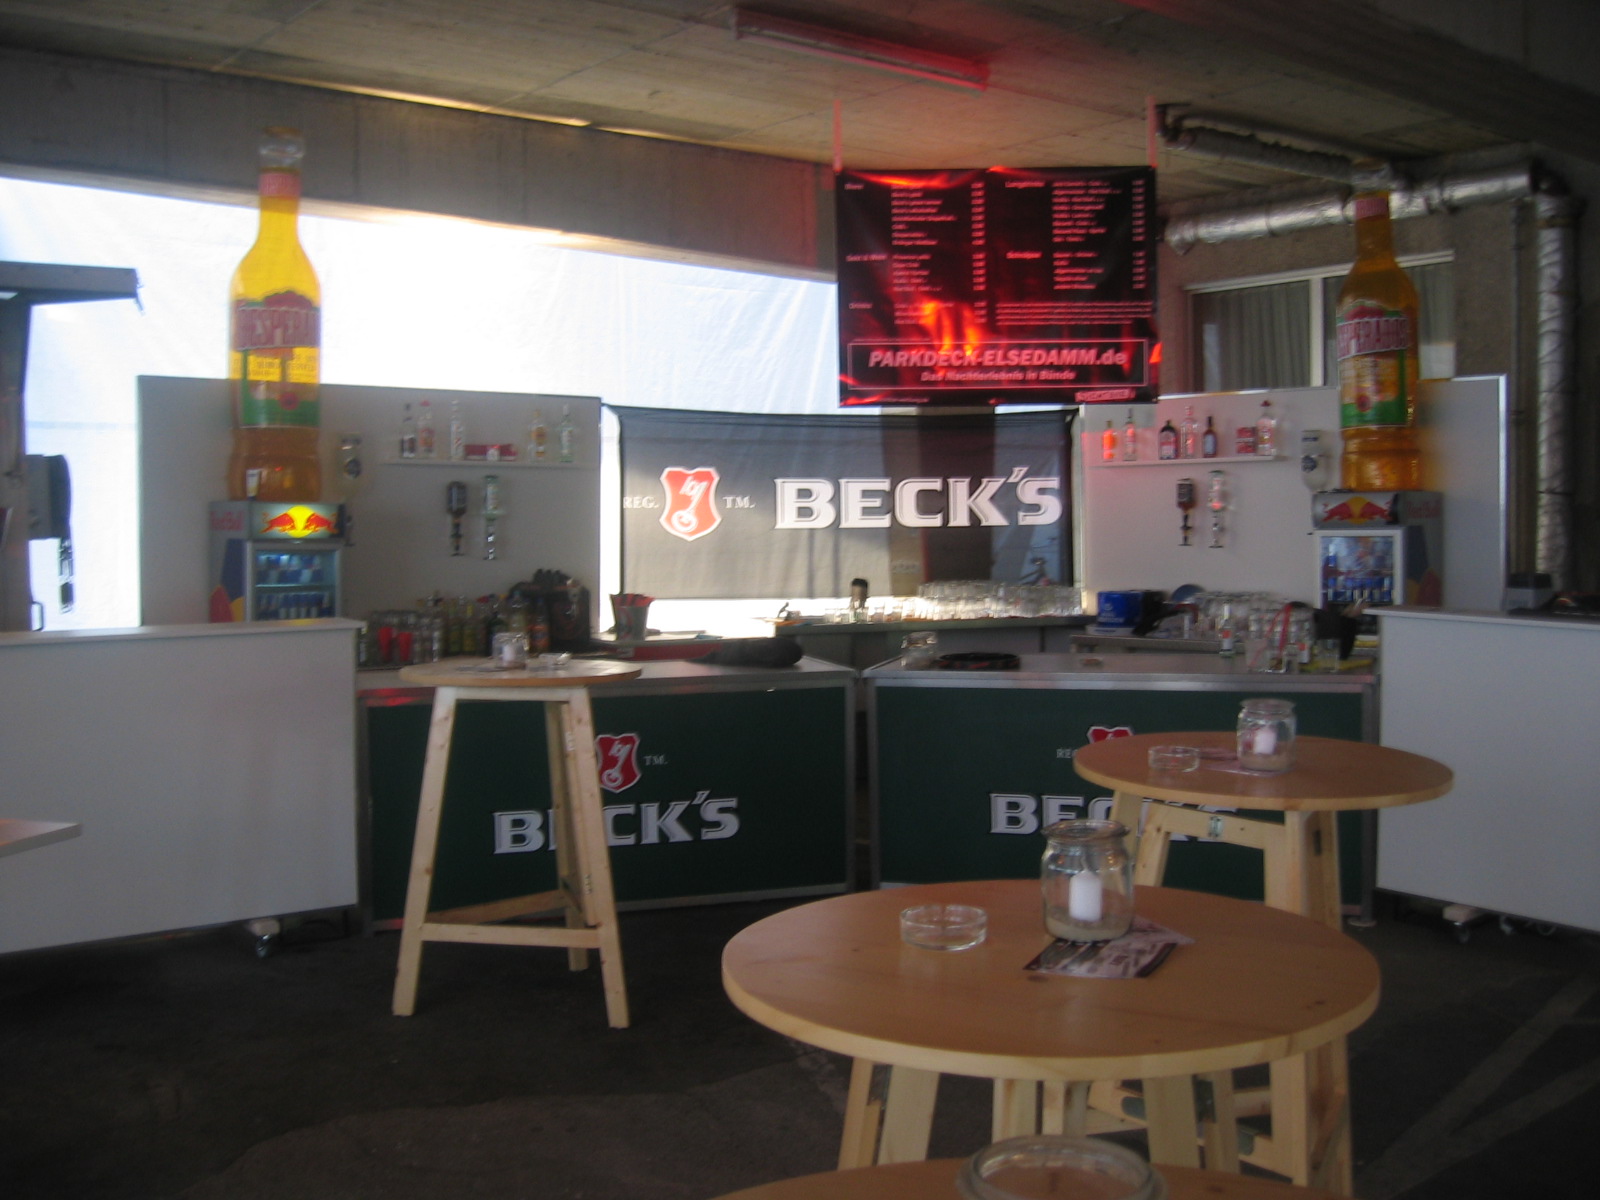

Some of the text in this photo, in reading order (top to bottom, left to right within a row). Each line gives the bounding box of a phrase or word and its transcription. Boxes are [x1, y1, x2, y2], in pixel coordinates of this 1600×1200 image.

[870, 348, 1127, 367] PARKDECK-ELSEDAMM.de
[722, 495, 756, 509] TM.
[774, 466, 1063, 529] BECK'S
[493, 790, 740, 855] BCK'S
